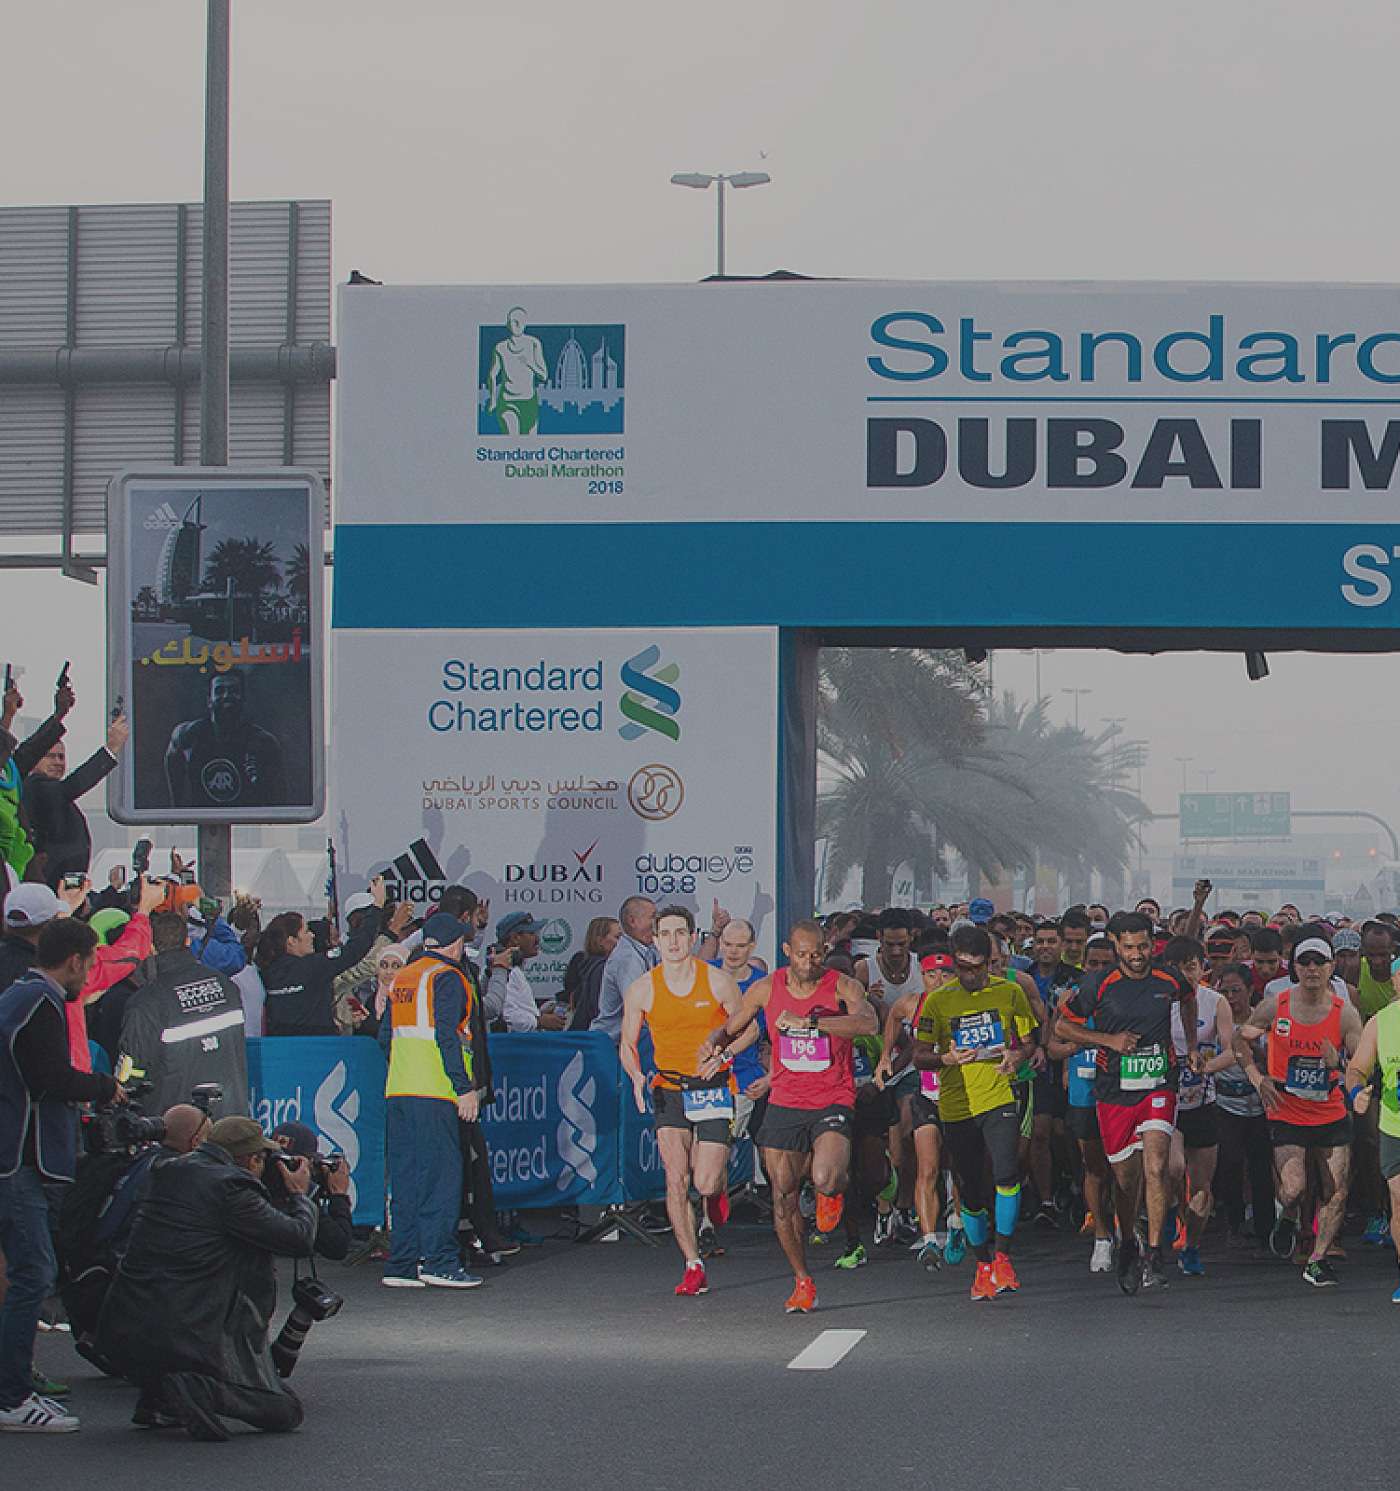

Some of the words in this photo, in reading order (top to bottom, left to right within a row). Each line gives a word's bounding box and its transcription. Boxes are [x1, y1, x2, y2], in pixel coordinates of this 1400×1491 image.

[476, 447, 545, 461] Standard
[548, 447, 624, 461] Chartered
[866, 417, 1263, 489] DUBAI
[505, 464, 548, 477] Dubai
[552, 464, 624, 477] Marathon
[588, 480, 624, 494] 2018
[442, 660, 603, 691] Standard
[428, 701, 603, 732] Chartered
[422, 776, 495, 796] الرياضي
[501, 779, 542, 795] دبي
[548, 776, 619, 795] مجلس
[422, 797, 472, 810] DUBAI
[478, 797, 540, 810] SPORTS
[547, 797, 618, 810] COUNCIL
[505, 864, 604, 882] DUBAI
[386, 879, 444, 903] dida
[636, 873, 696, 894] 103.8
[505, 888, 603, 903] HOLDING
[961, 1025, 995, 1045] 2351
[791, 1039, 816, 1056] 196
[1127, 1056, 1164, 1073] 11709
[1295, 1068, 1325, 1084] 1964
[690, 1090, 724, 1105] 1544
